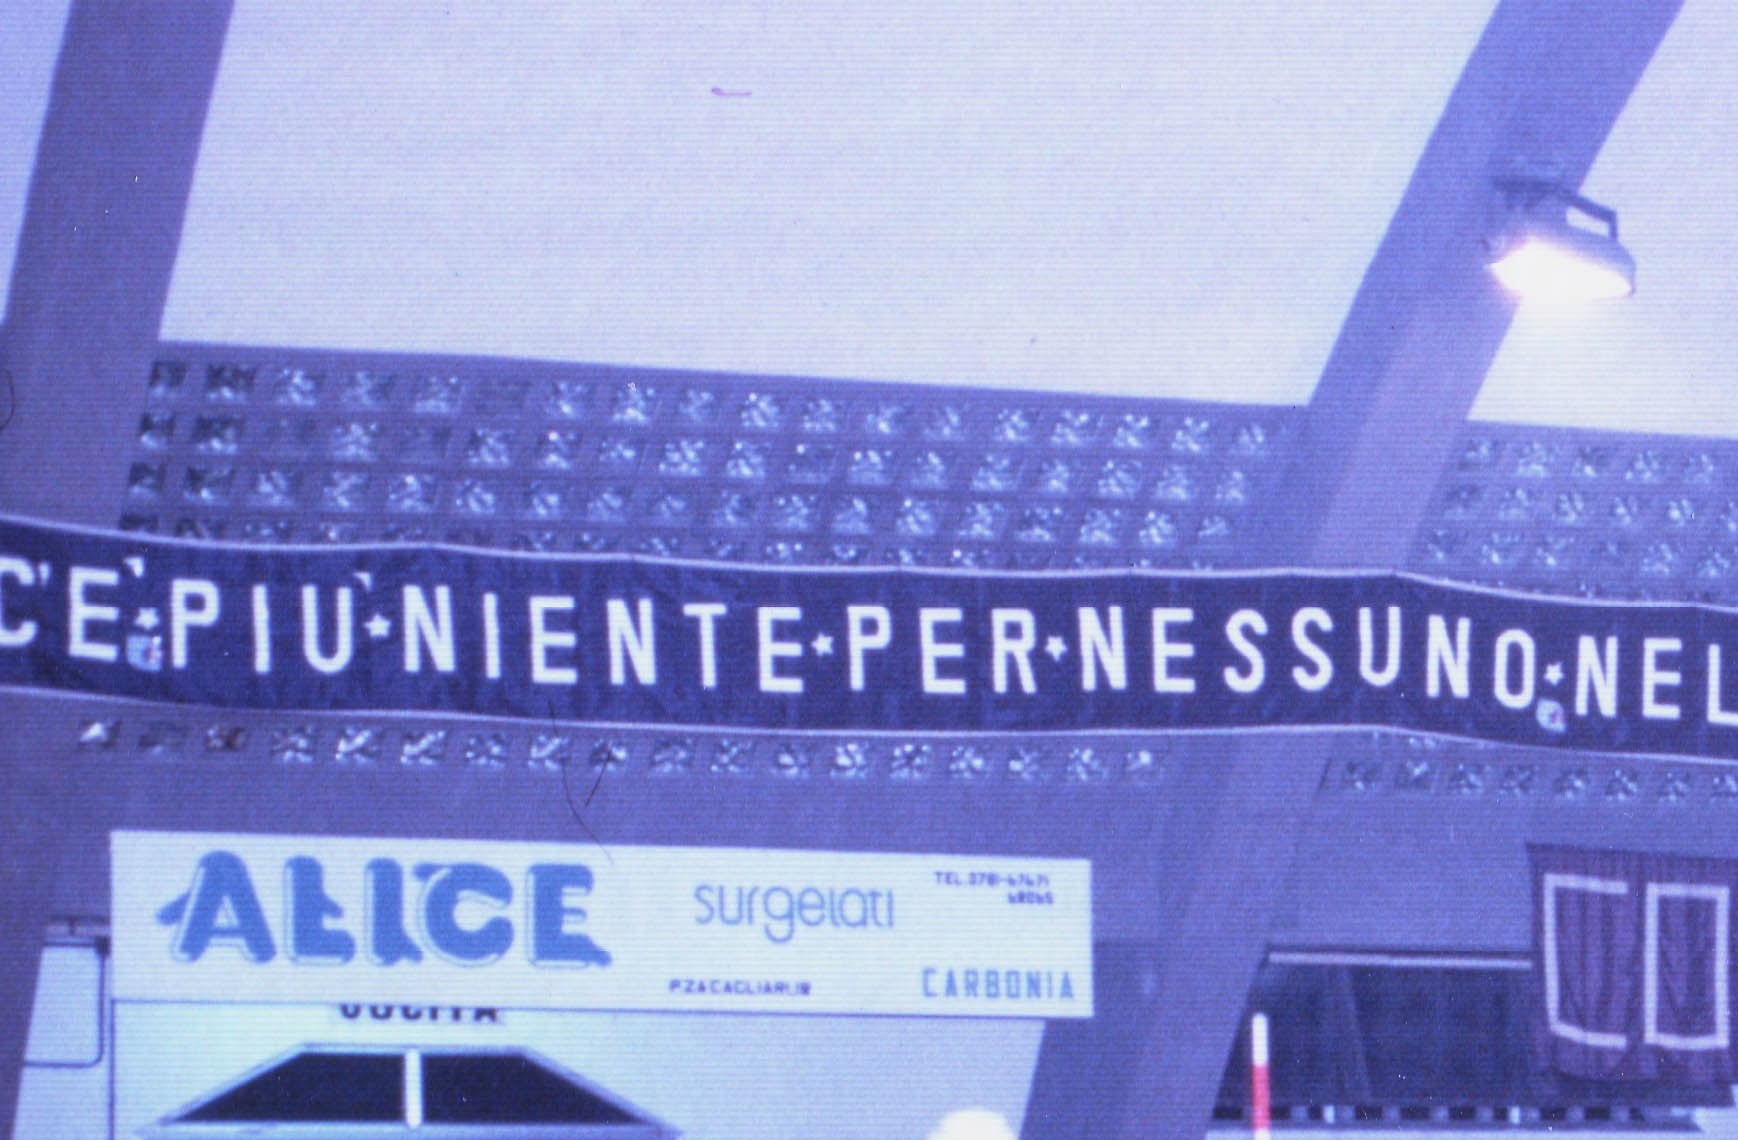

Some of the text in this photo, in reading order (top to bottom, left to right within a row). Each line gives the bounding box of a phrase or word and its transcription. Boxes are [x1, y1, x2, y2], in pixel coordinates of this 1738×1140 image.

[403, 585, 804, 694] NIENTE
[847, 605, 1036, 694] PER
[1078, 605, 1536, 710] NESSUNO
[155, 848, 613, 968] ALICE
[693, 882, 896, 944] surgelati
[921, 966, 1075, 1000] CARBONIA
